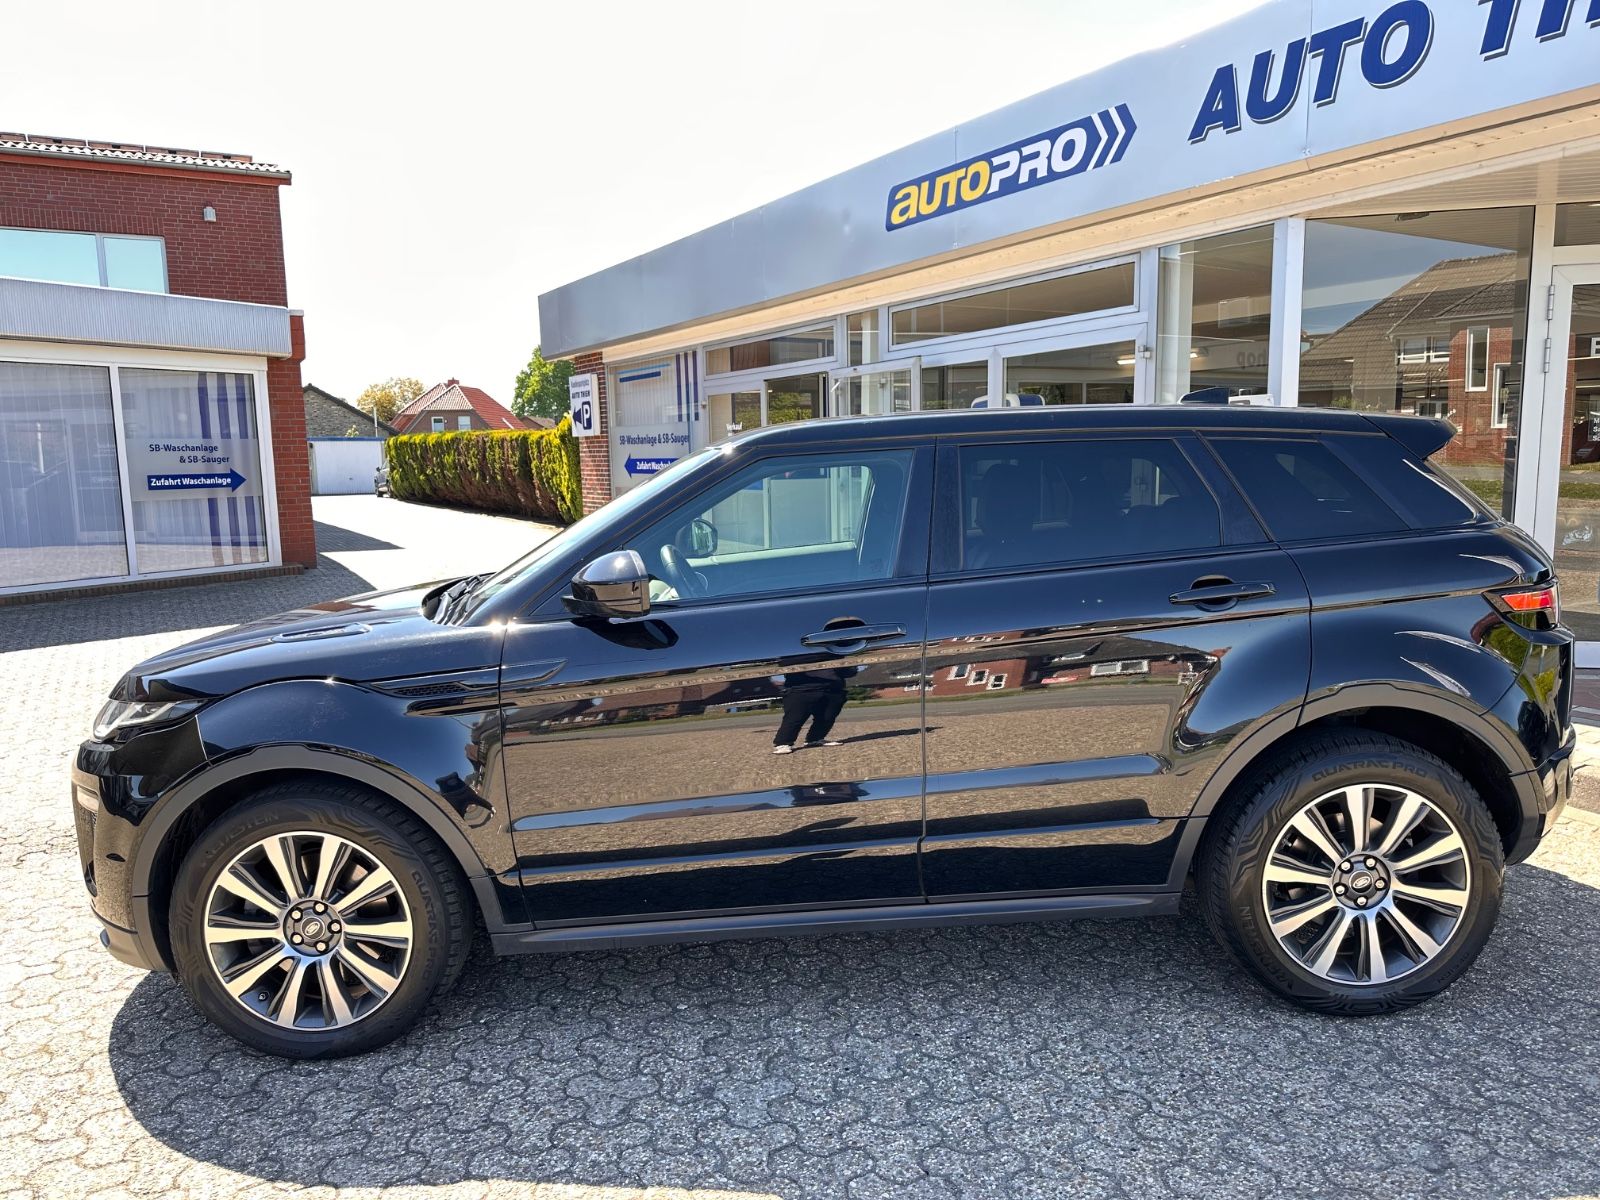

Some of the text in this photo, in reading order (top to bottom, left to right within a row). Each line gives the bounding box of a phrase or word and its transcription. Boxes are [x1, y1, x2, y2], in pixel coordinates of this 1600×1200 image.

[1187, 0, 1434, 145] AUTO
[619, 434, 657, 447] SB-Waschanlage
[657, 433, 662, 444] &
[149, 444, 219, 453] SB-Waschanlage
[179, 455, 230, 464] & SB-Sauger
[150, 476, 232, 487] Zufahrt Waschanlage
[1311, 759, 1428, 782] QUATRAC PRO
